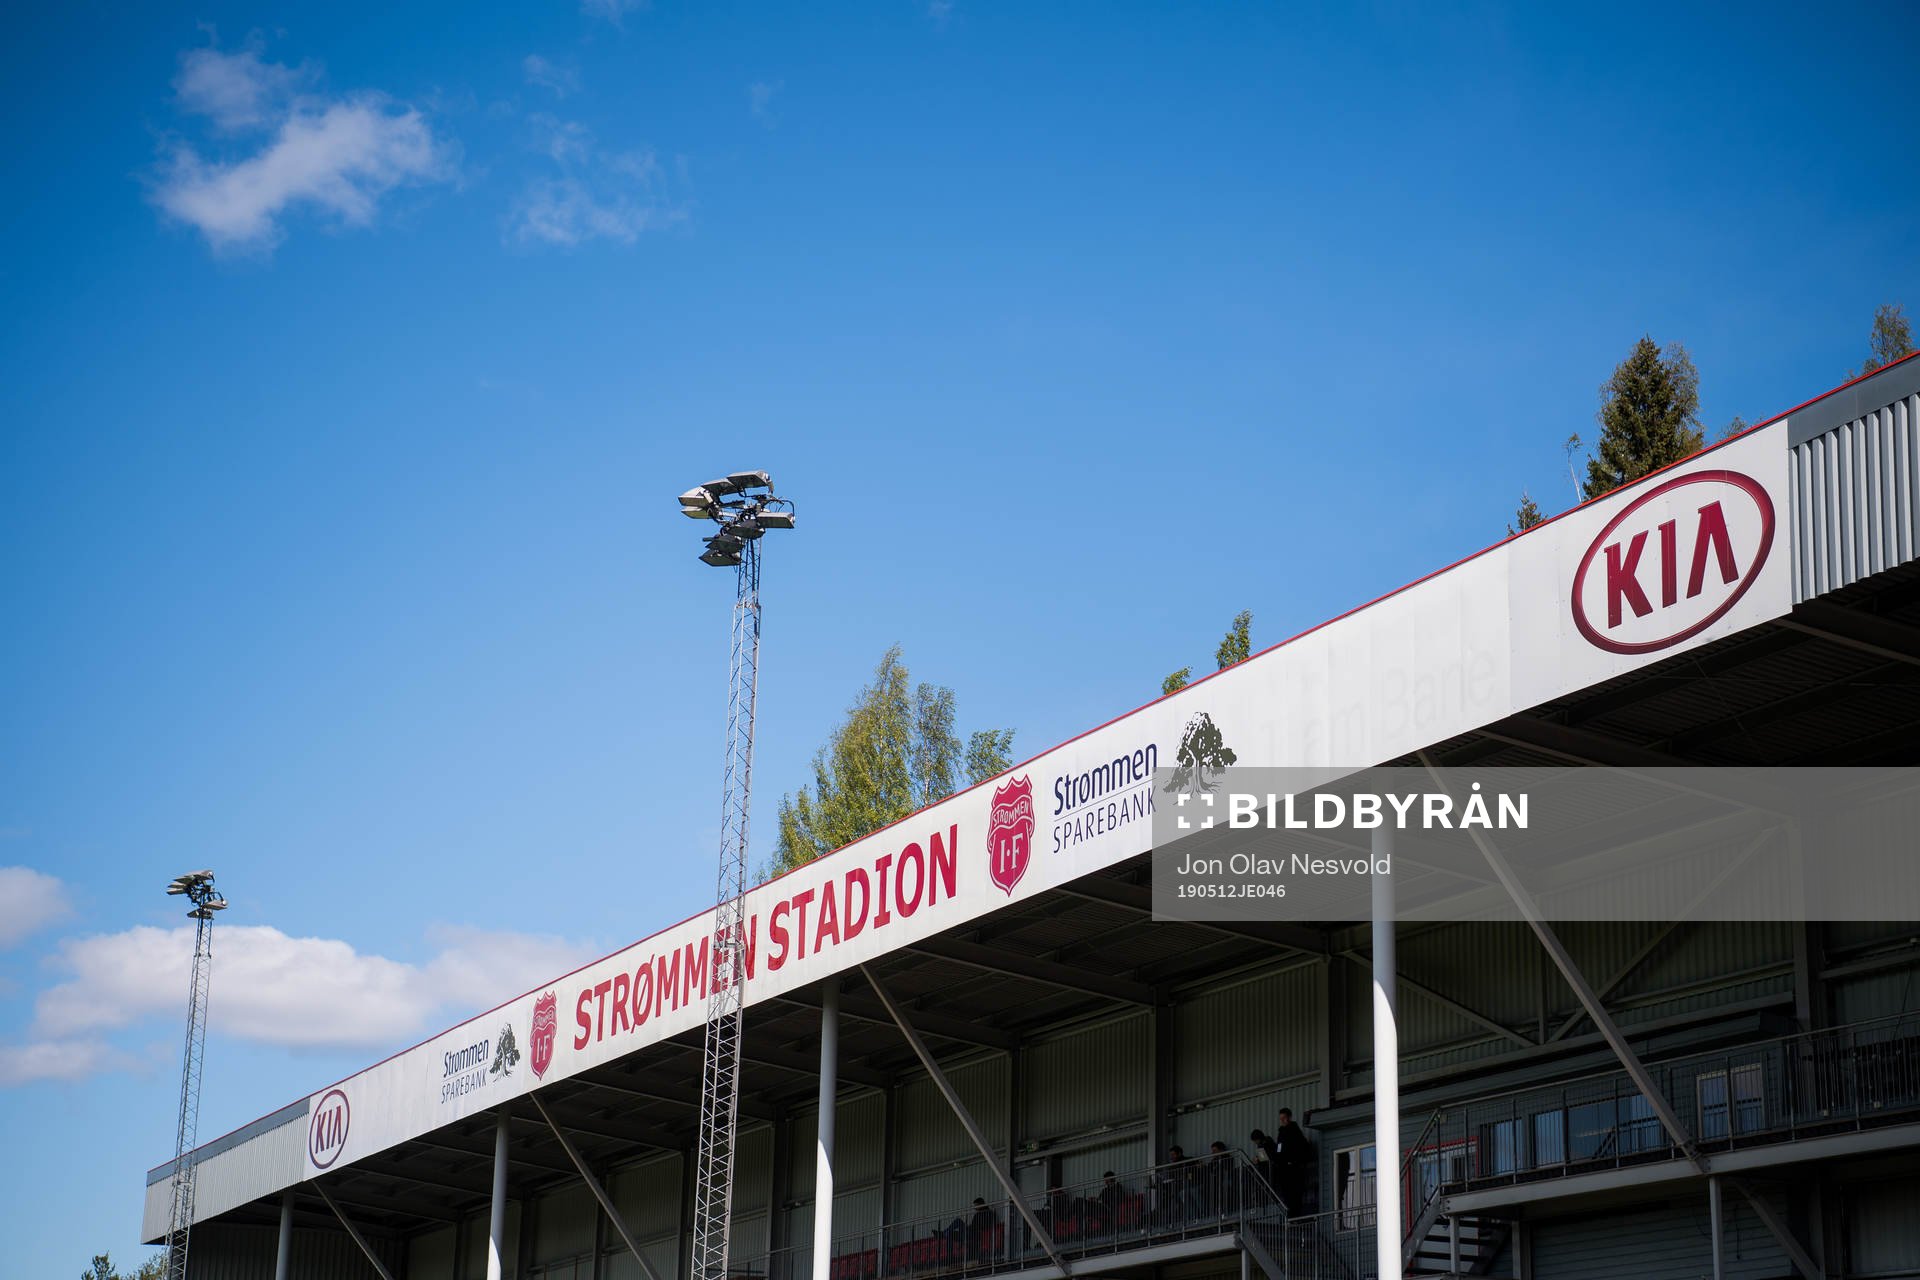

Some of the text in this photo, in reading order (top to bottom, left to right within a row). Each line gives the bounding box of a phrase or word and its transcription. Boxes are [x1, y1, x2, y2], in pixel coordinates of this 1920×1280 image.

[1603, 500, 1739, 629] KIA
[1054, 743, 1157, 816] Strømmen
[1053, 785, 1157, 854] SPAREBANK
[574, 824, 958, 1050] STRØMMEN STADION
[441, 1067, 488, 1104] SPAREBANK
[315, 1105, 342, 1154] KIA
